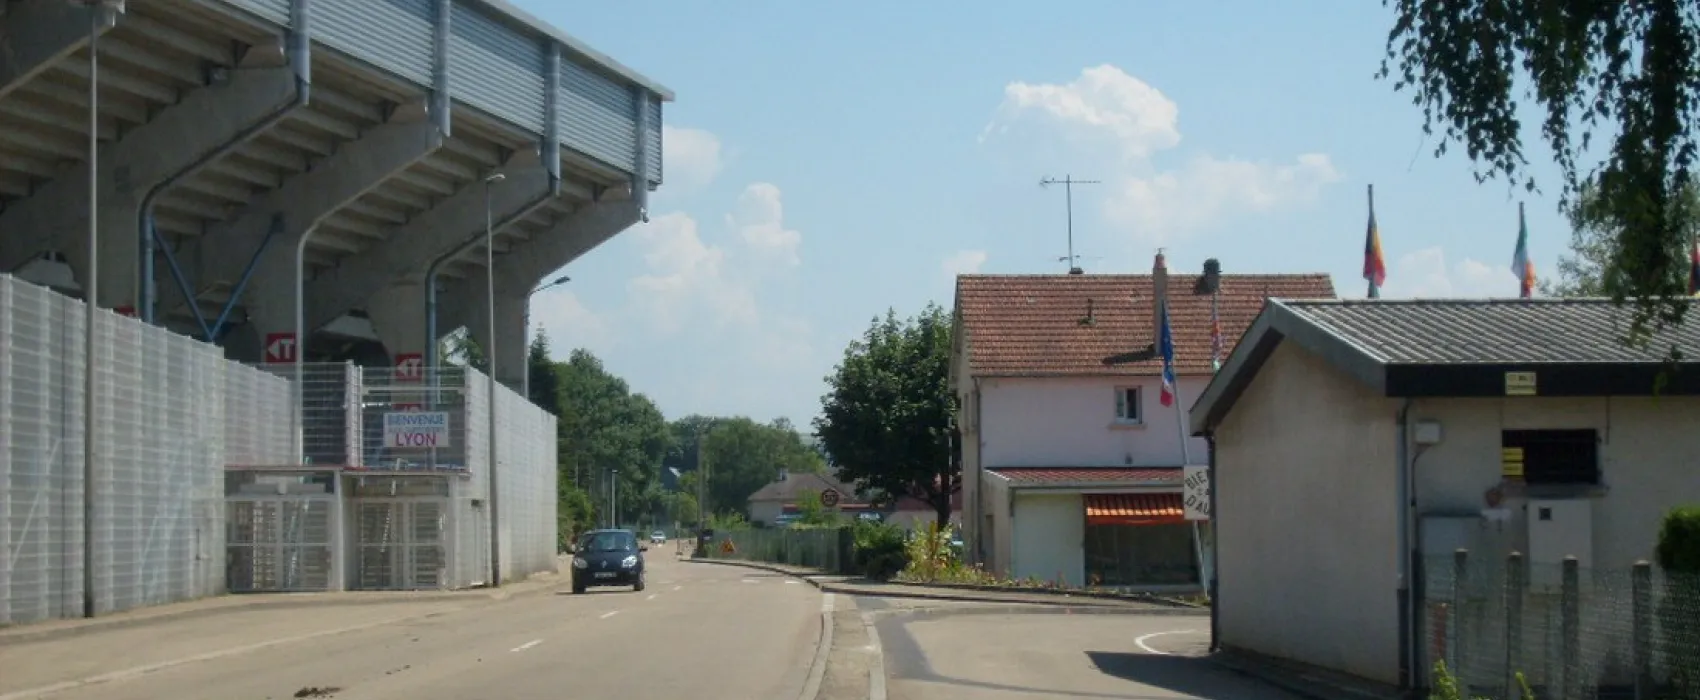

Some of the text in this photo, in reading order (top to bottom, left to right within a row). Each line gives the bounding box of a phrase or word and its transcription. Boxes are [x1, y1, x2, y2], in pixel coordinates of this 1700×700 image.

[280, 339, 295, 360] T
[408, 358, 421, 377] T
[387, 414, 445, 426] BIENVENUE
[395, 432, 437, 446] LYON
